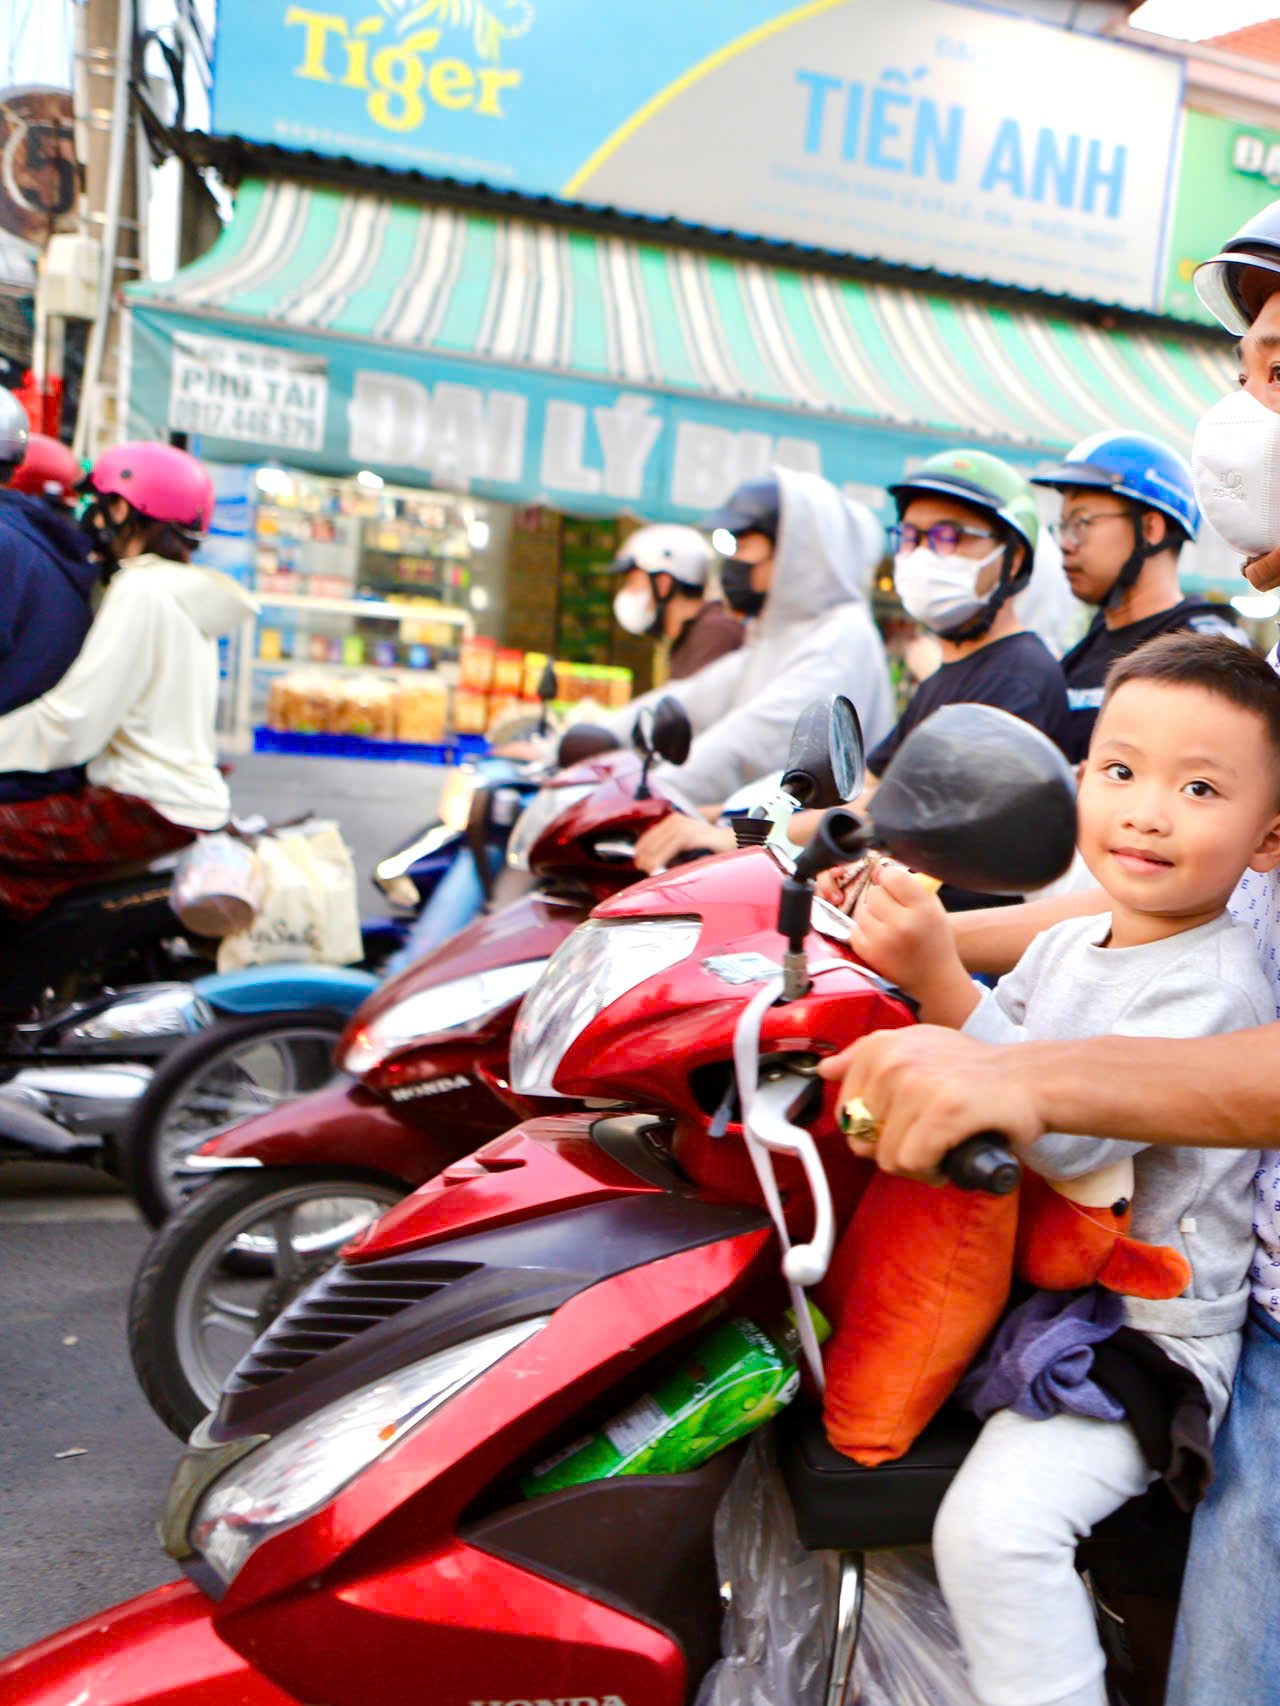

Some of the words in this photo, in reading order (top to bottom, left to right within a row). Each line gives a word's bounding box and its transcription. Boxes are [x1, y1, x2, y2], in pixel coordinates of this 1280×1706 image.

[284, 8, 521, 132] Tiger
[795, 64, 966, 185] TIẾN
[978, 117, 1129, 219] ANH
[540, 391, 664, 500] LÝ
[390, 1074, 473, 1103] HONDA
